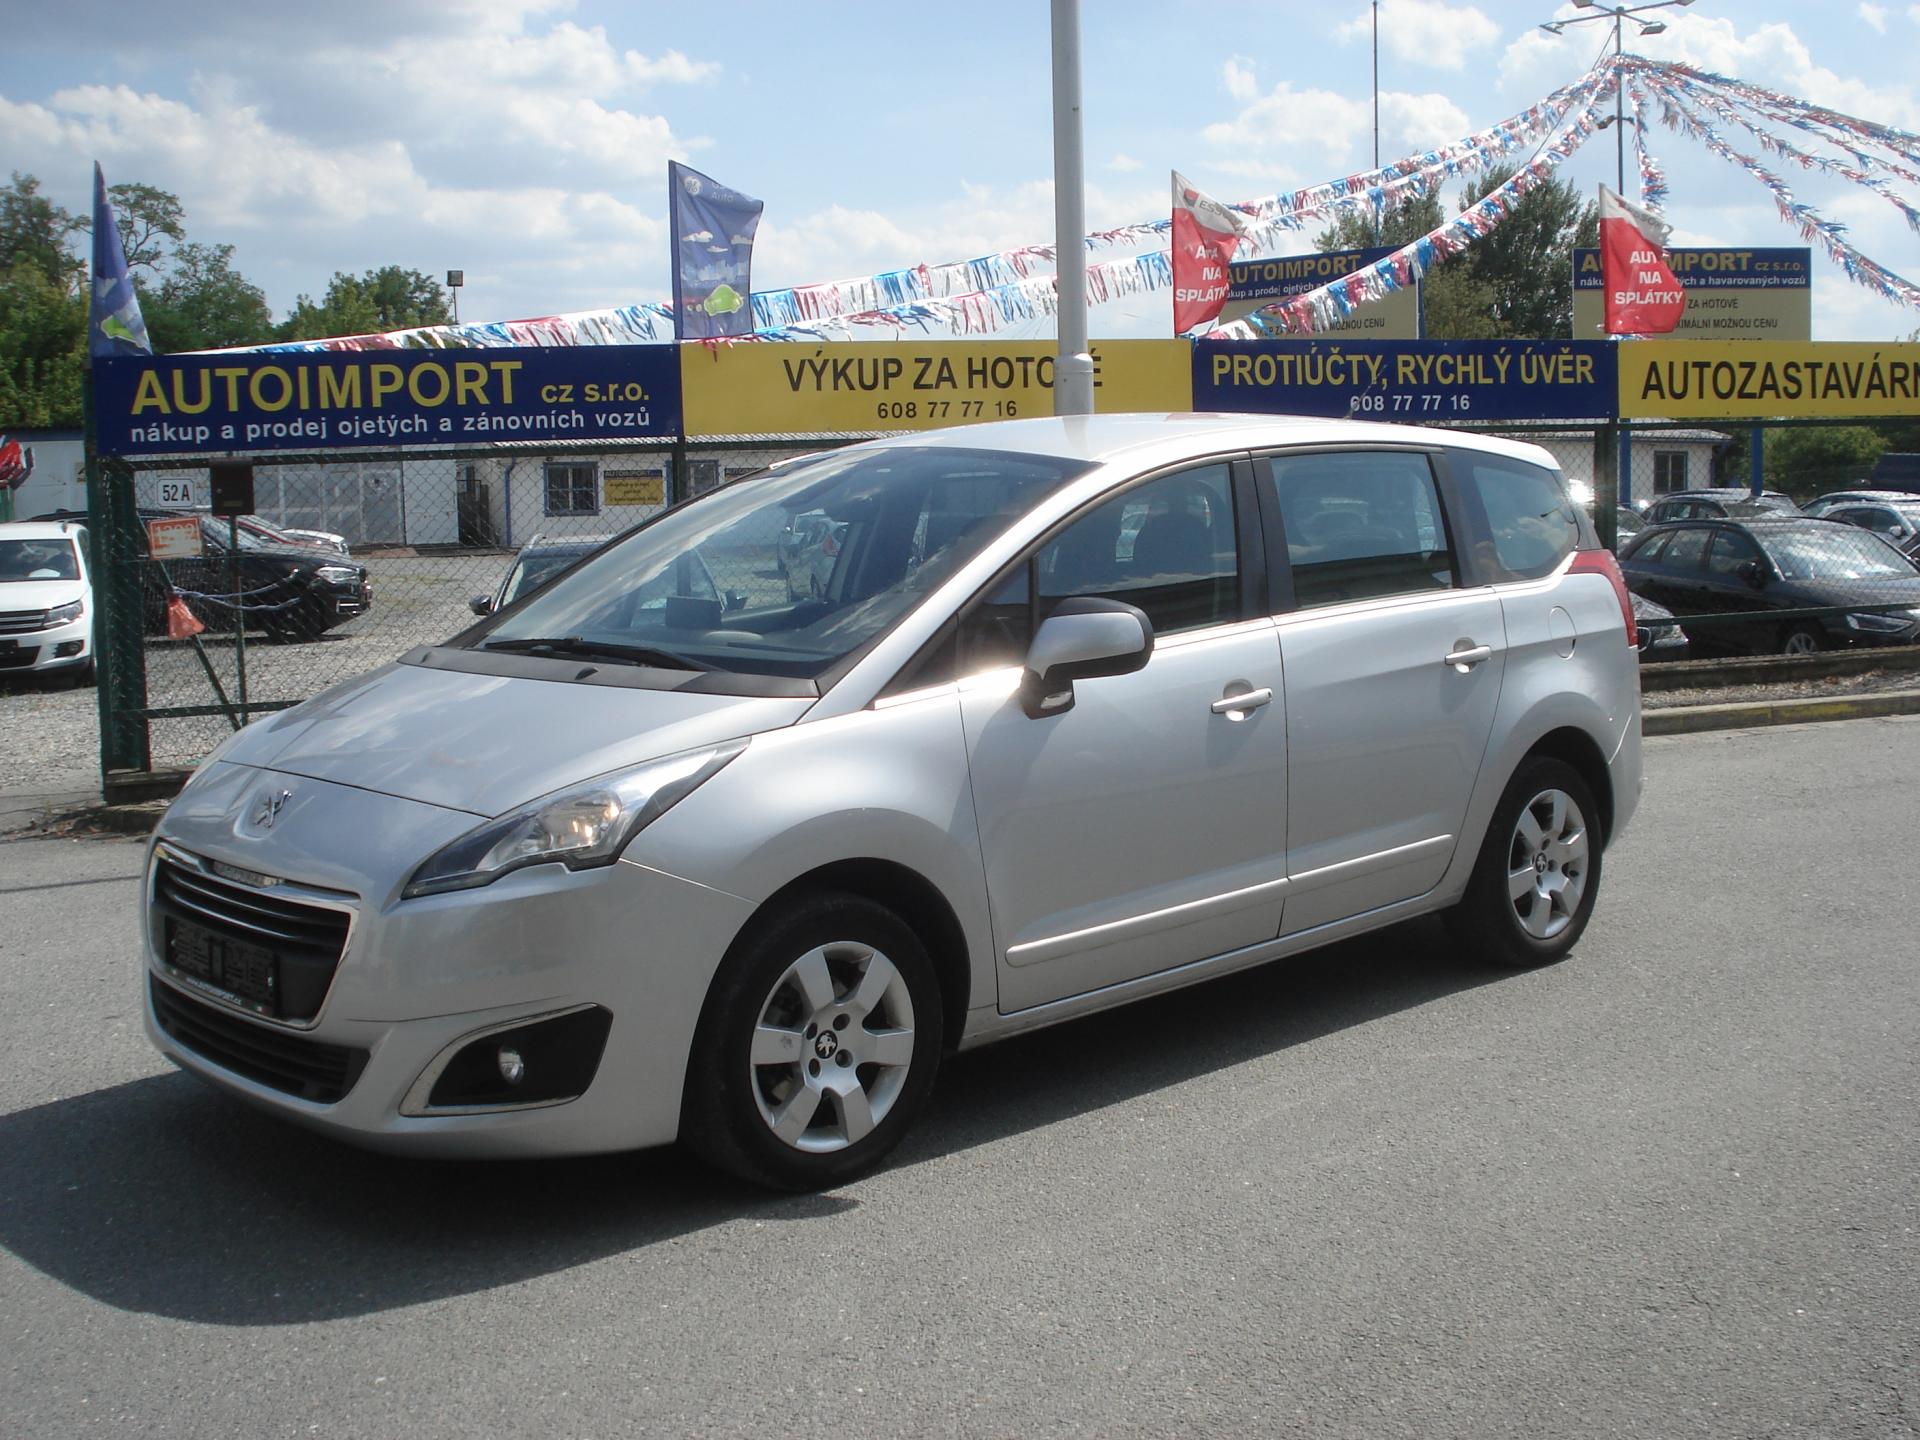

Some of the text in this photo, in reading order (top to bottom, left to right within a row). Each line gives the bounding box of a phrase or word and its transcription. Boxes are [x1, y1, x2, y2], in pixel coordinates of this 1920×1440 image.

[1202, 267, 1222, 280] NA
[1755, 262, 1769, 271] cz
[1773, 261, 1804, 271] s.r.o.
[1639, 271, 1662, 285] NA
[1699, 277, 1706, 285] a
[1708, 275, 1780, 287] havarovaných
[1255, 285, 1280, 298] prodej
[1615, 289, 1683, 305] SPLÁTKY
[1688, 297, 1739, 309] ZA HOTOVÉ
[1363, 318, 1385, 328] CENU
[1713, 315, 1751, 328] MOŽNOU
[1753, 318, 1778, 328] CENU
[784, 347, 1103, 391] VÝKUP ZA HOTOÉ
[1213, 347, 1595, 390] PROTIÚČTY, RYCHLÝ ÚVĚR
[131, 361, 650, 415] AUTOIMPORT cz s.r.o.
[877, 400, 1018, 418] 608 77 77 16
[1350, 395, 1471, 412] 608 77 77 16
[131, 406, 650, 444] nákup a prodej ojetých a zánovních vozů
[163, 484, 190, 501] 52 A
